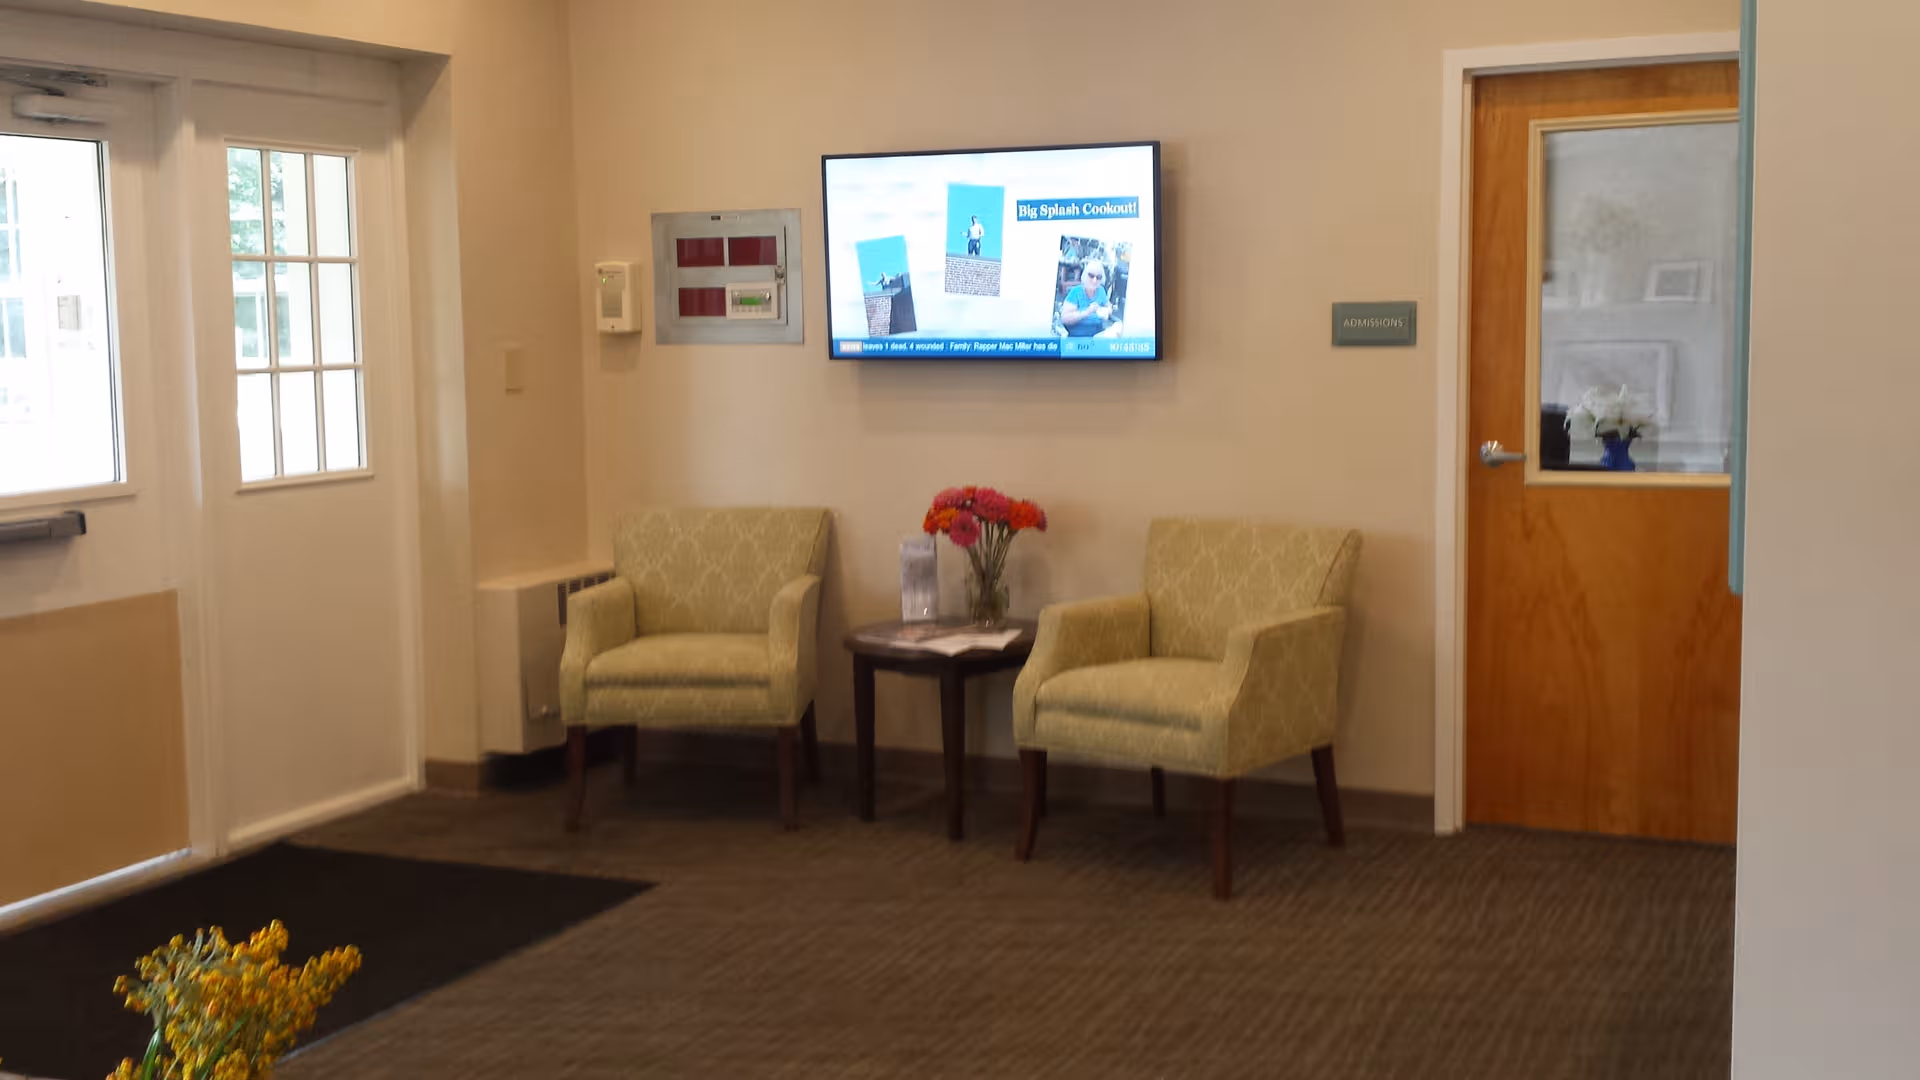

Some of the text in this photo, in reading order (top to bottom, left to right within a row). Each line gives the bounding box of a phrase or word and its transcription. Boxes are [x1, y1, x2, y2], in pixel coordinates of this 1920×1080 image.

[1018, 201, 1137, 219] Big Splash Cookout!
[1343, 317, 1404, 329] ADMISSIONS
[915, 342, 945, 351] wounded
[973, 342, 998, 352] Rapper
